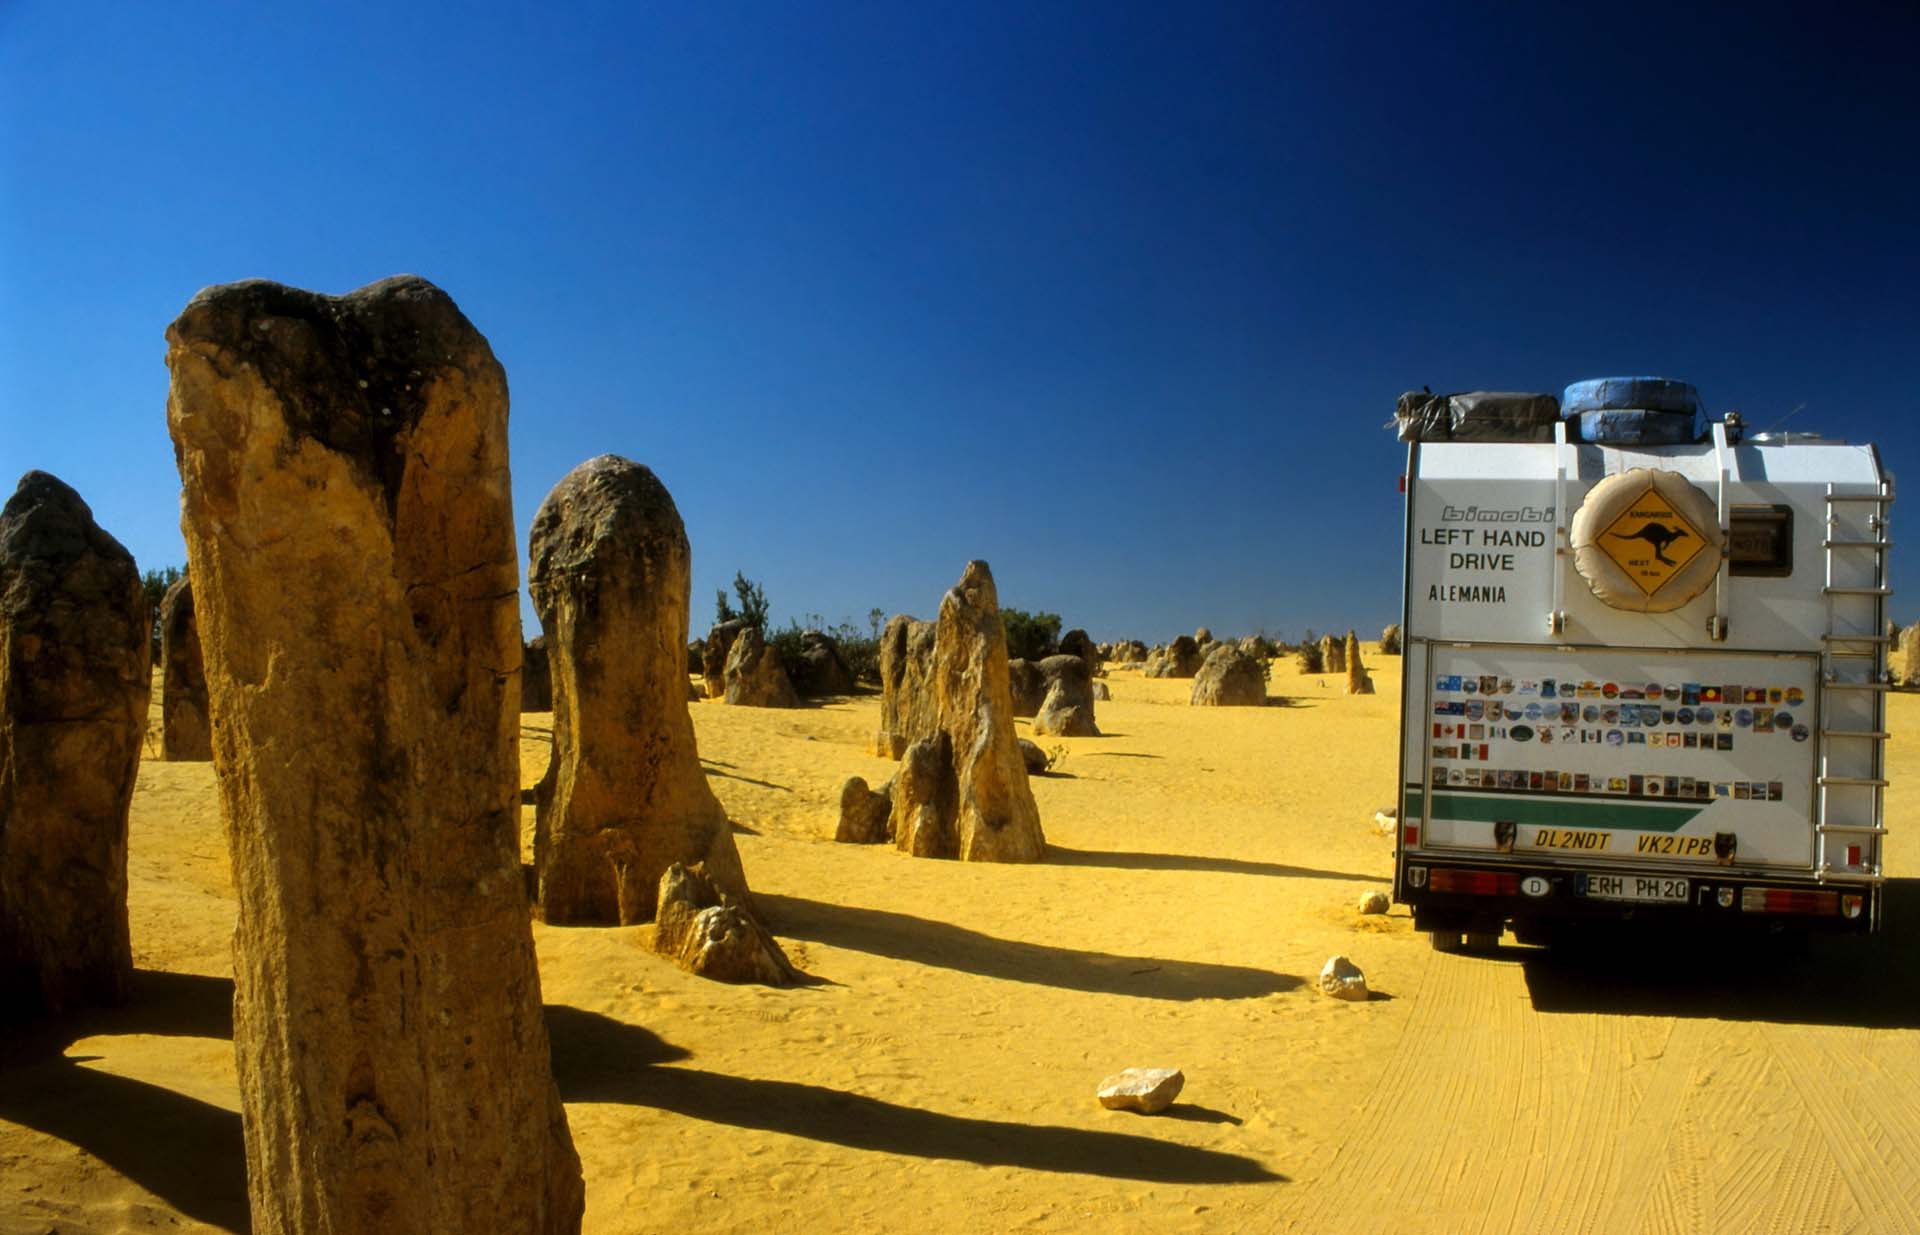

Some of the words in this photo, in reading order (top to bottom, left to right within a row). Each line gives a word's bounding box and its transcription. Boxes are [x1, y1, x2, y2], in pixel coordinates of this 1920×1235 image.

[1441, 506, 1556, 523] bimobi
[1421, 528, 1474, 545] LEFT
[1483, 529, 1546, 547] HAND
[1450, 552, 1515, 571] DRIVE
[1429, 584, 1506, 603] ALEMANIA
[1536, 829, 1611, 850] DL2NDT
[1530, 880, 1541, 893] D
[1587, 876, 1623, 896] ERH
